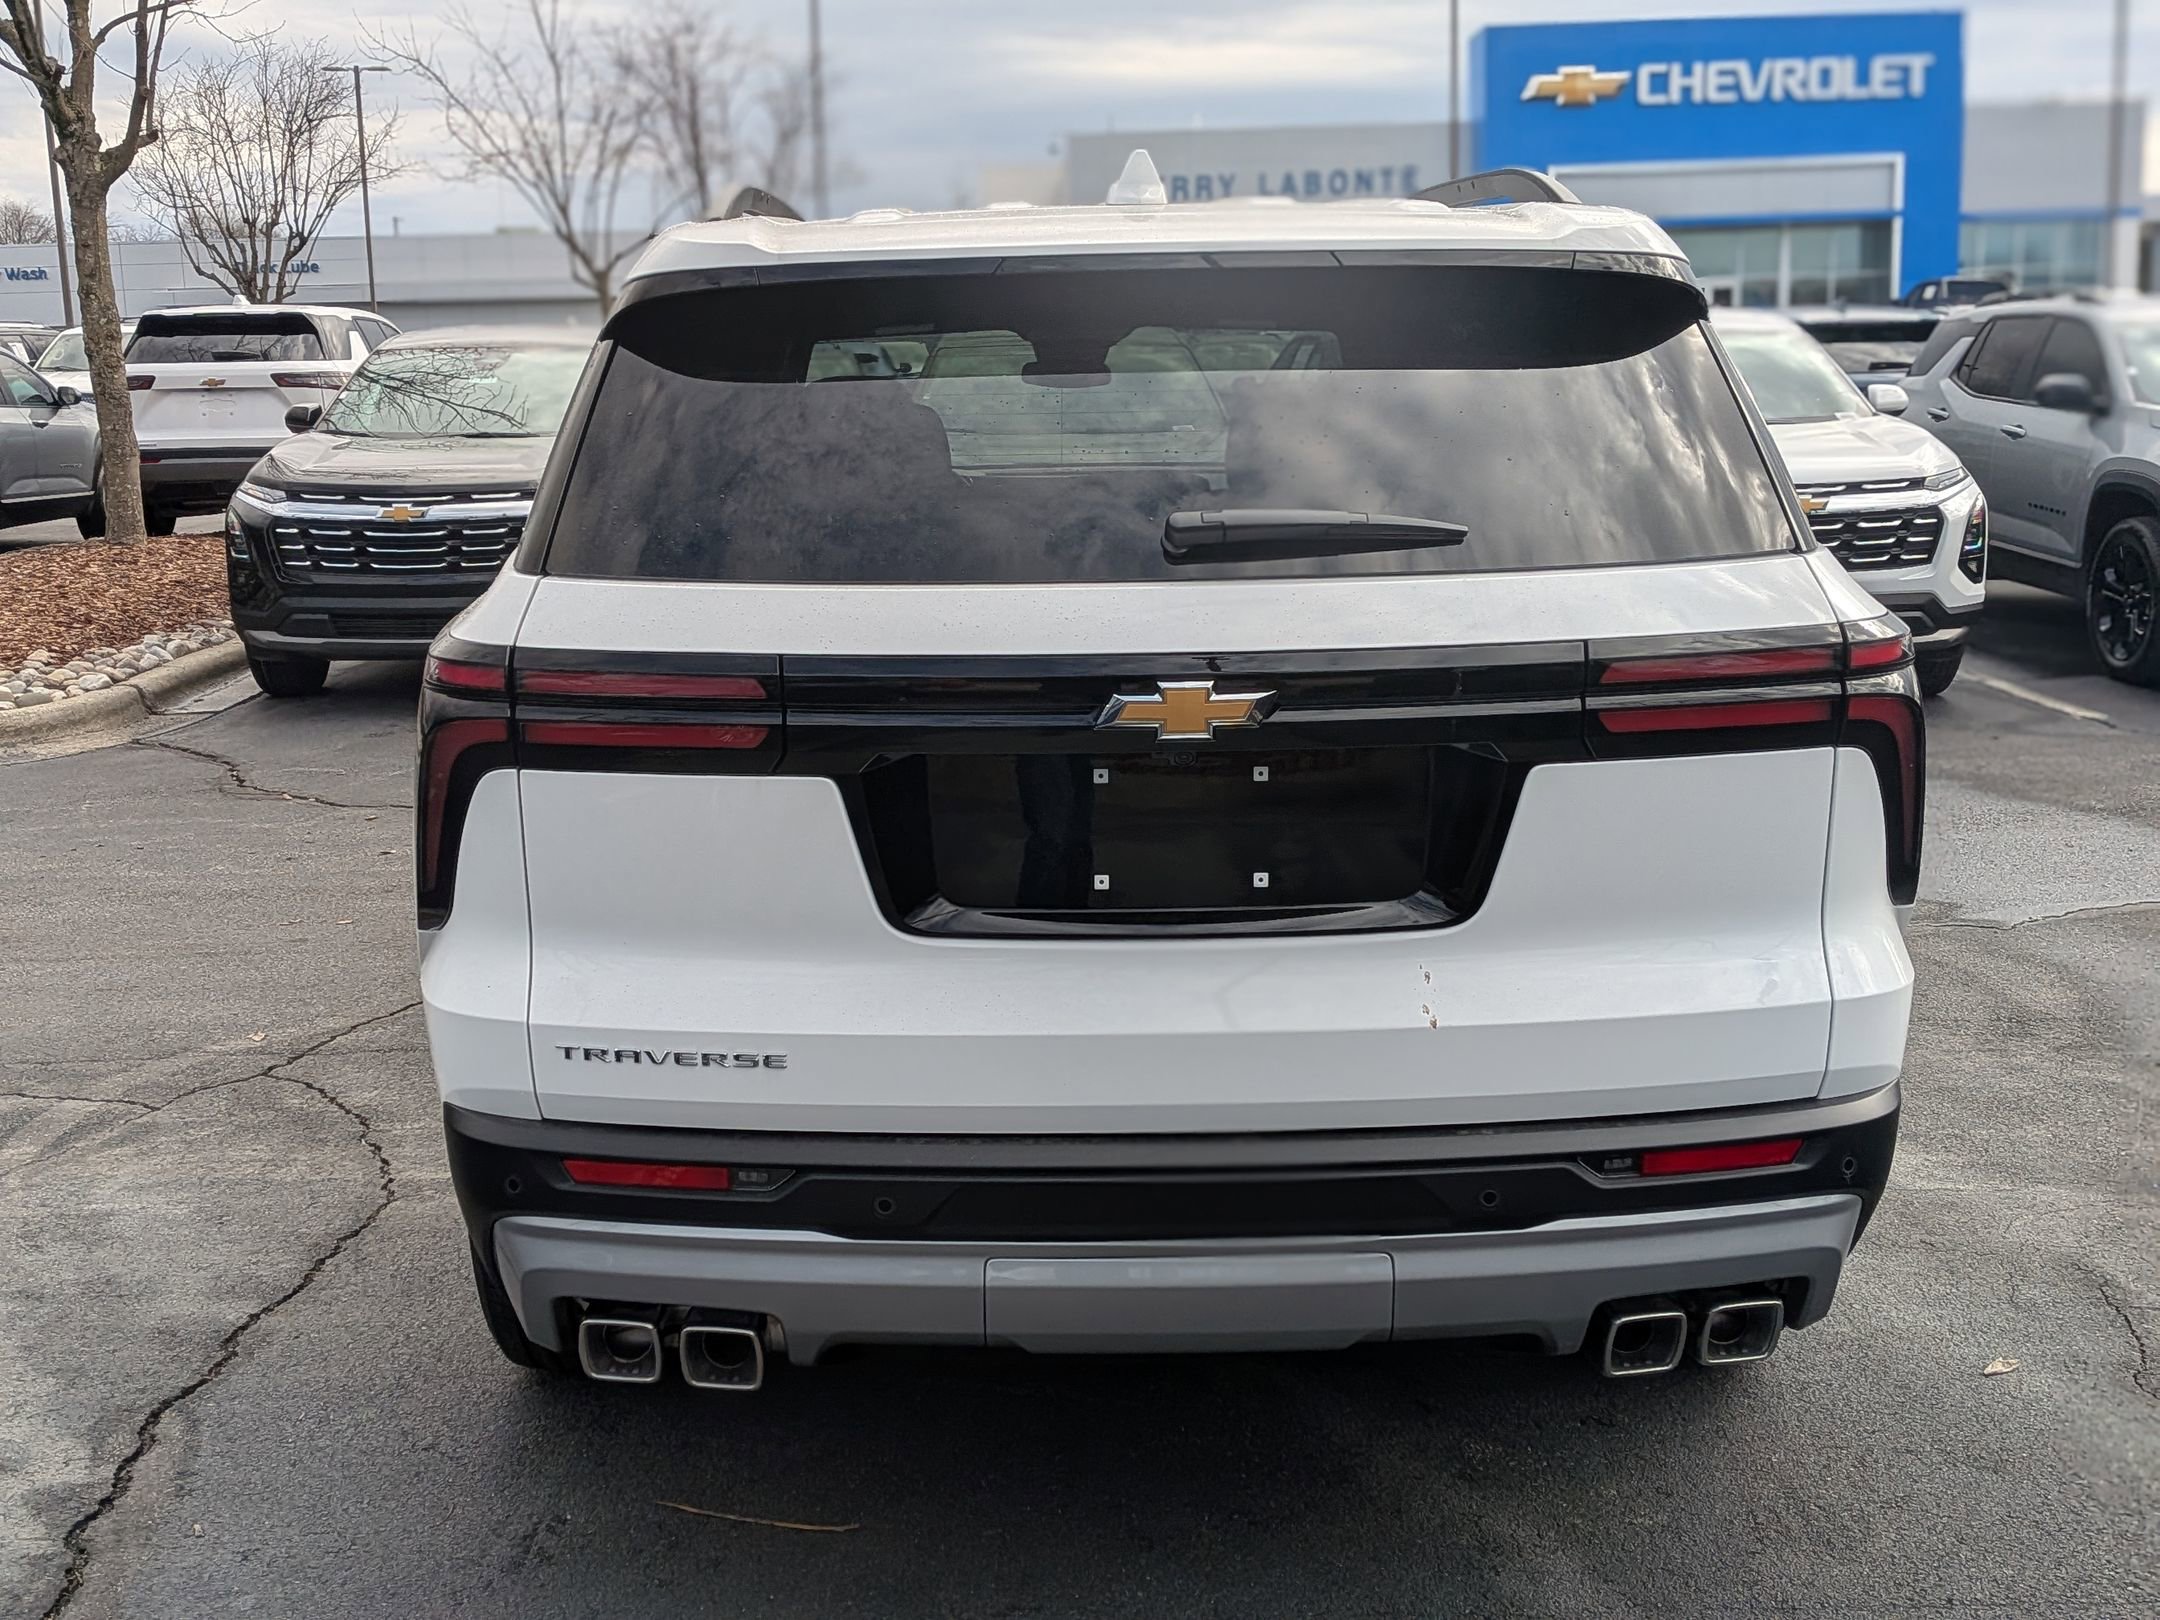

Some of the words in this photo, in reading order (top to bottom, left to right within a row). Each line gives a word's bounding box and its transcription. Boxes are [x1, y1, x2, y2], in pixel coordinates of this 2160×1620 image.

[1637, 53, 1935, 105] CHEVROLET
[1161, 173, 1237, 201] RRY
[1258, 164, 1419, 198] LABONTE
[4, 267, 48, 280] Wash
[555, 1044, 787, 1069] TRAVERSE
